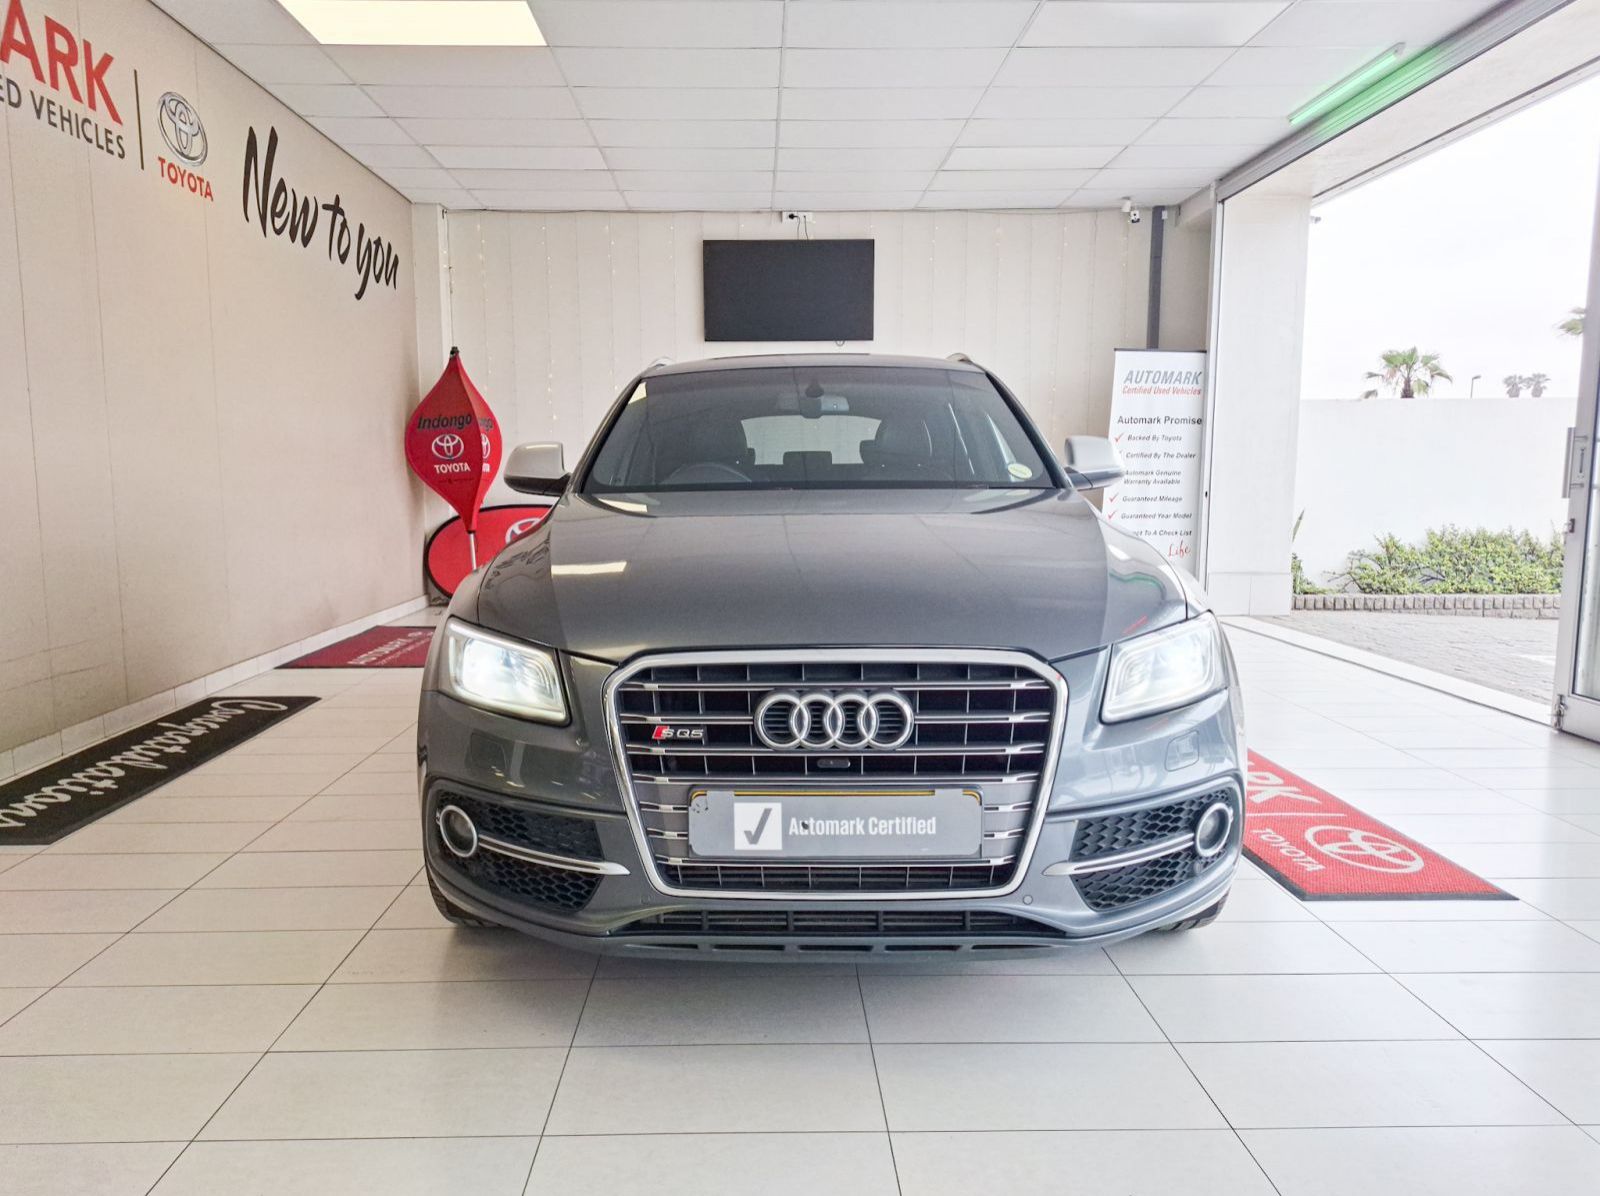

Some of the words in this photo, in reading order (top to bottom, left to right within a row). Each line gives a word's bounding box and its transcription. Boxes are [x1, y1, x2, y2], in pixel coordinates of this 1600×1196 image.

[30, 90, 125, 159] VEHICLES
[158, 156, 213, 202] TOYOTA
[243, 126, 318, 248] New
[322, 194, 350, 265] to
[355, 223, 399, 300] you
[1123, 370, 1203, 385] AUTOMARK
[1122, 386, 1152, 395] Certified
[1153, 386, 1171, 395] Used
[1171, 387, 1202, 396] Vehicles
[417, 413, 473, 430] Indongo
[1117, 415, 1161, 425] Automark
[1163, 415, 1203, 425] Promise
[1151, 434, 1160, 443] By
[1161, 434, 1182, 443] Toyota
[1125, 451, 1152, 459] Certified
[1153, 451, 1161, 460] By
[1163, 451, 1175, 459] The
[1176, 451, 1197, 459] Dealer
[434, 462, 471, 474] TOYOTA
[1155, 469, 1182, 477] Genuine
[1123, 478, 1152, 486] Warranty
[1159, 495, 1183, 503] Mileage
[1121, 512, 1156, 520] Guaranteed
[1144, 529, 1152, 537] To
[1158, 529, 1179, 537] Check
[1179, 529, 1193, 537] List
[1168, 539, 1191, 558] Life
[657, 727, 704, 739] SQ5
[0, 699, 288, 827] Congratulations
[788, 817, 865, 835] Automark
[868, 816, 937, 835] Certified
[1250, 827, 1326, 872] TOYOTA
